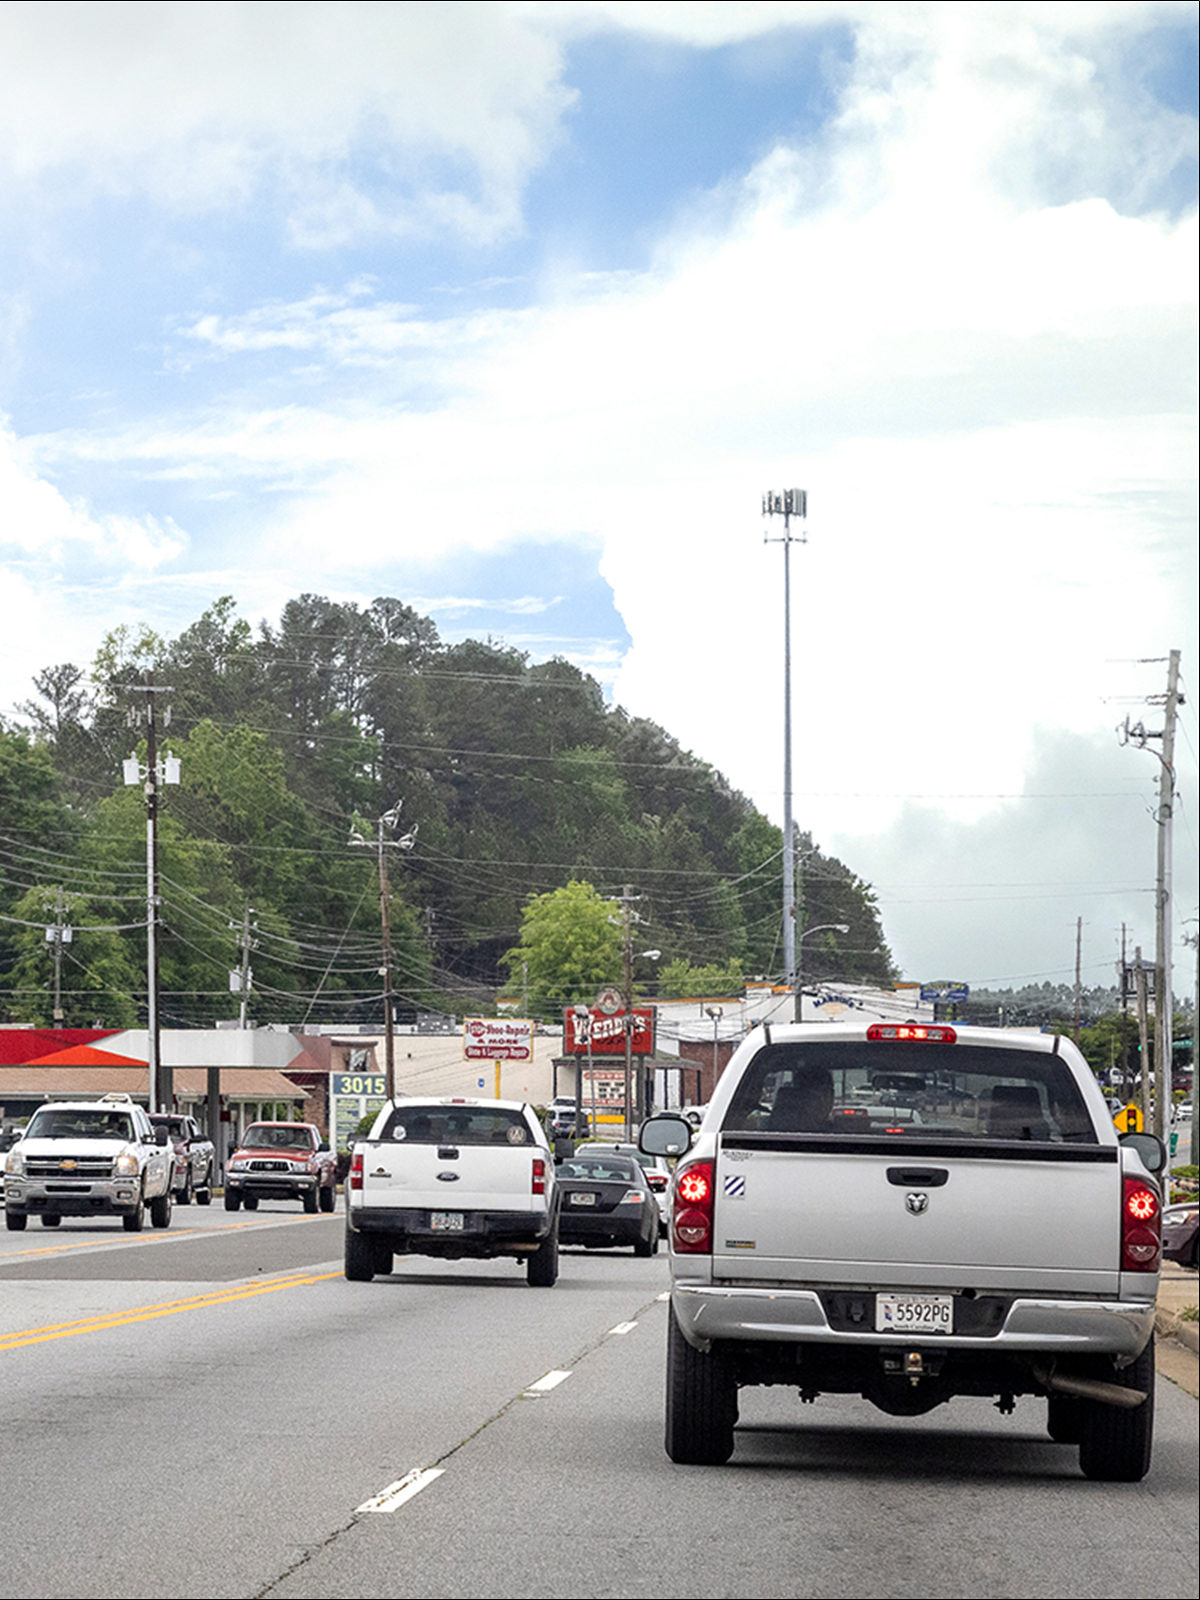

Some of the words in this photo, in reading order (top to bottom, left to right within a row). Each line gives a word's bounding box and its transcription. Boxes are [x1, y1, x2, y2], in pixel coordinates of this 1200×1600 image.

[506, 1024, 530, 1037] Repair
[341, 1076, 385, 1094] 3015
[897, 1304, 949, 1322] 5592PG
